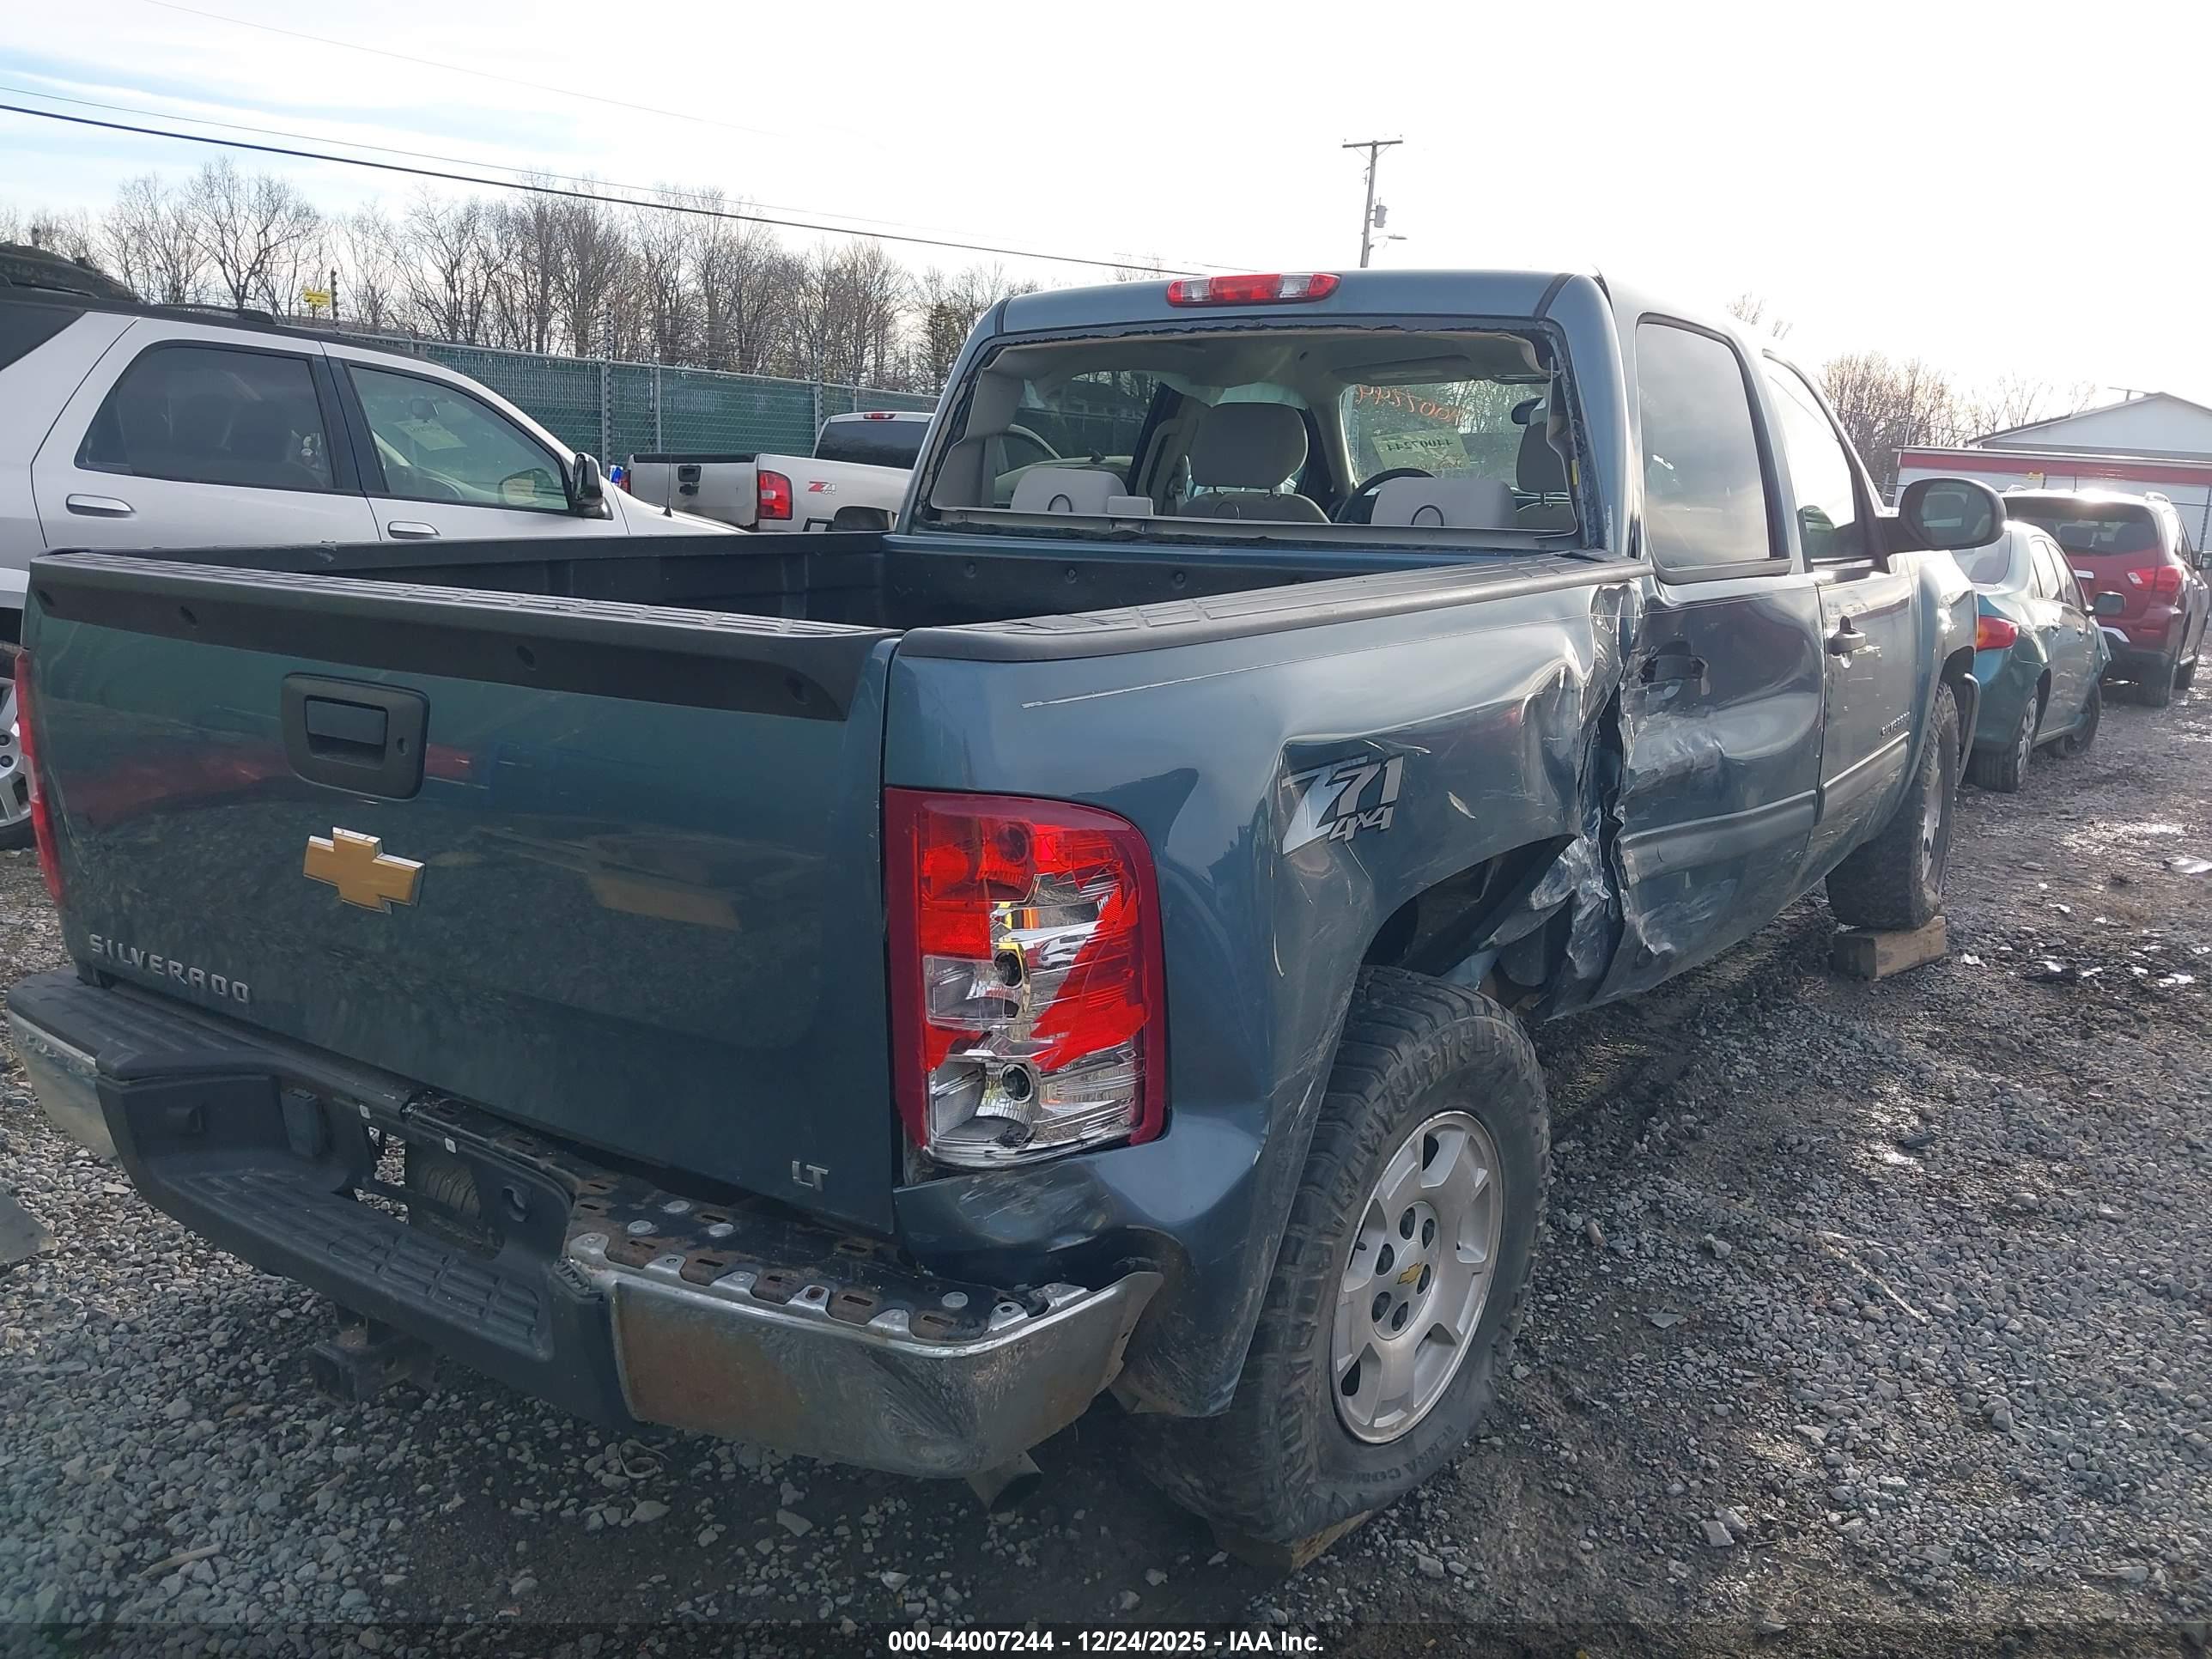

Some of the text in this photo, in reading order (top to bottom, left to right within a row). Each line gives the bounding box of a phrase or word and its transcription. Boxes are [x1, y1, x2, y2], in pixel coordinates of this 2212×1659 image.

[1281, 754, 1404, 855] Z71
[88, 933, 249, 1005] SILVERADO
[792, 1159, 830, 1192] LT
